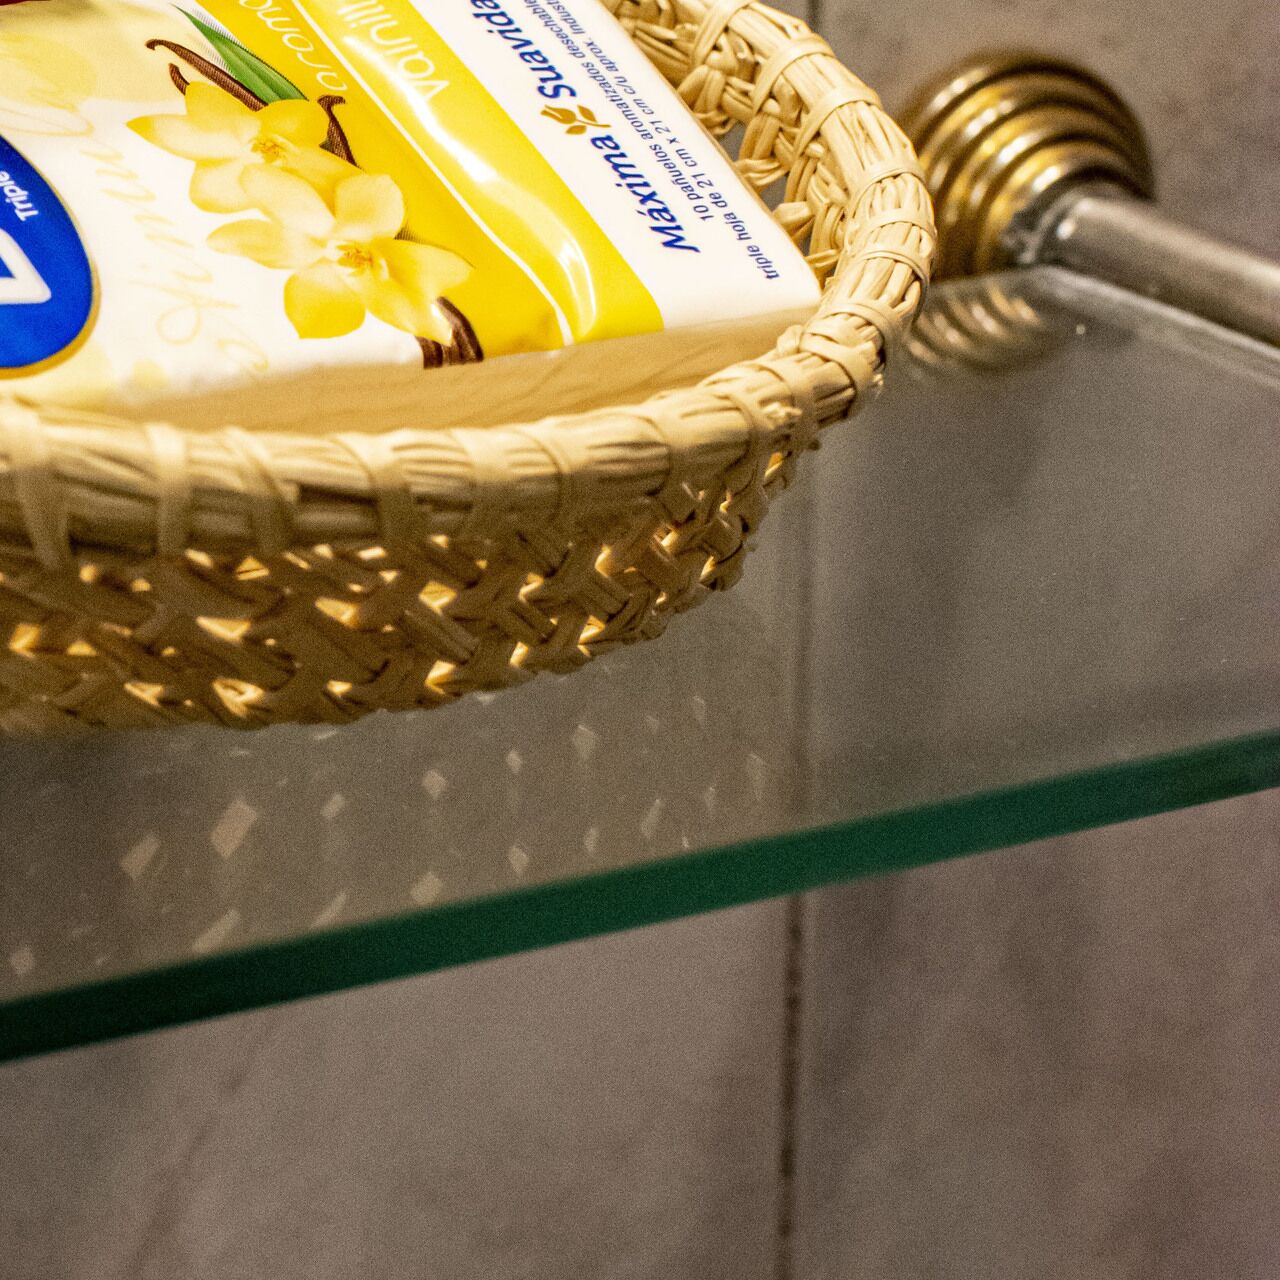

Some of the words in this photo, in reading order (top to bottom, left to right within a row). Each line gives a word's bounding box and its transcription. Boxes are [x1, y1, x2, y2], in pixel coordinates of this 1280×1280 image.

[584, 40, 619, 76] aprox.
[614, 77, 636, 95] c/u
[581, 62, 653, 141] aromatizados
[633, 99, 655, 116] cm
[650, 119, 672, 136] 21
[676, 150, 698, 168] cm
[650, 144, 698, 201] pañuelos
[692, 173, 714, 189] 21
[591, 134, 701, 253] Máxima
[708, 192, 728, 211] de
[692, 199, 716, 222] 10
[724, 214, 752, 242] hoja
[746, 244, 780, 280] triple
